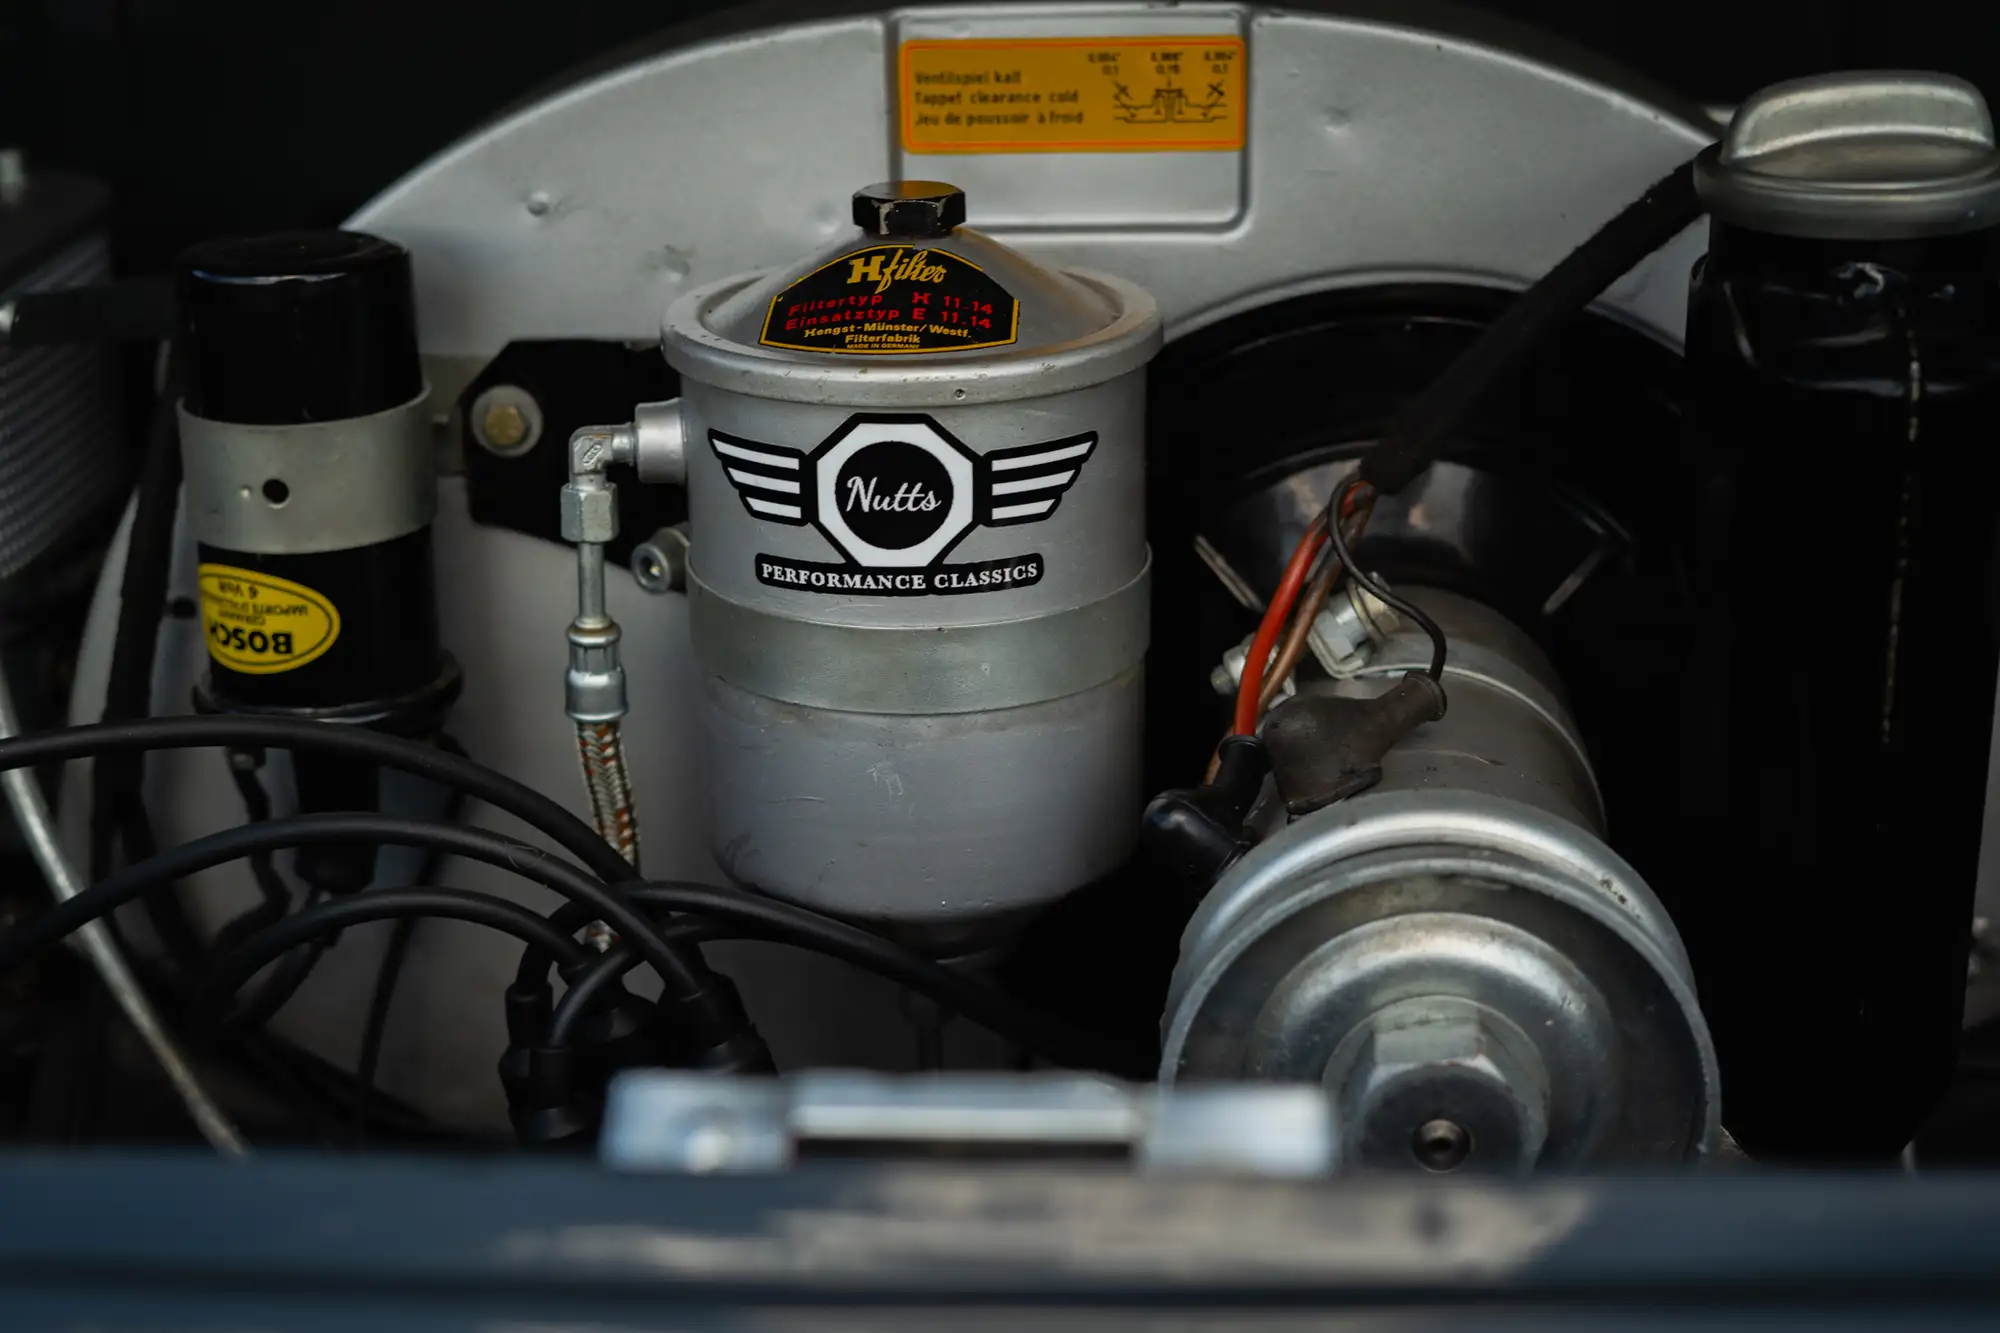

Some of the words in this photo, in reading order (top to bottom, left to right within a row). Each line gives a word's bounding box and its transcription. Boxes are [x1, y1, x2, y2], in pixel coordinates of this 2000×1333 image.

[915, 91, 962, 107] Tappet
[970, 89, 1042, 104] clearance
[1049, 89, 1078, 104] cold
[944, 111, 961, 126] de
[788, 295, 883, 317] Filtertyp
[911, 292, 931, 305] H
[785, 308, 900, 331] Einsatztyp
[912, 307, 927, 320] E
[844, 333, 921, 344] Filterfabrik
[845, 475, 942, 513] Nutts
[761, 562, 926, 590] PERFORMANCE
[933, 562, 1038, 588] CLASSICS
